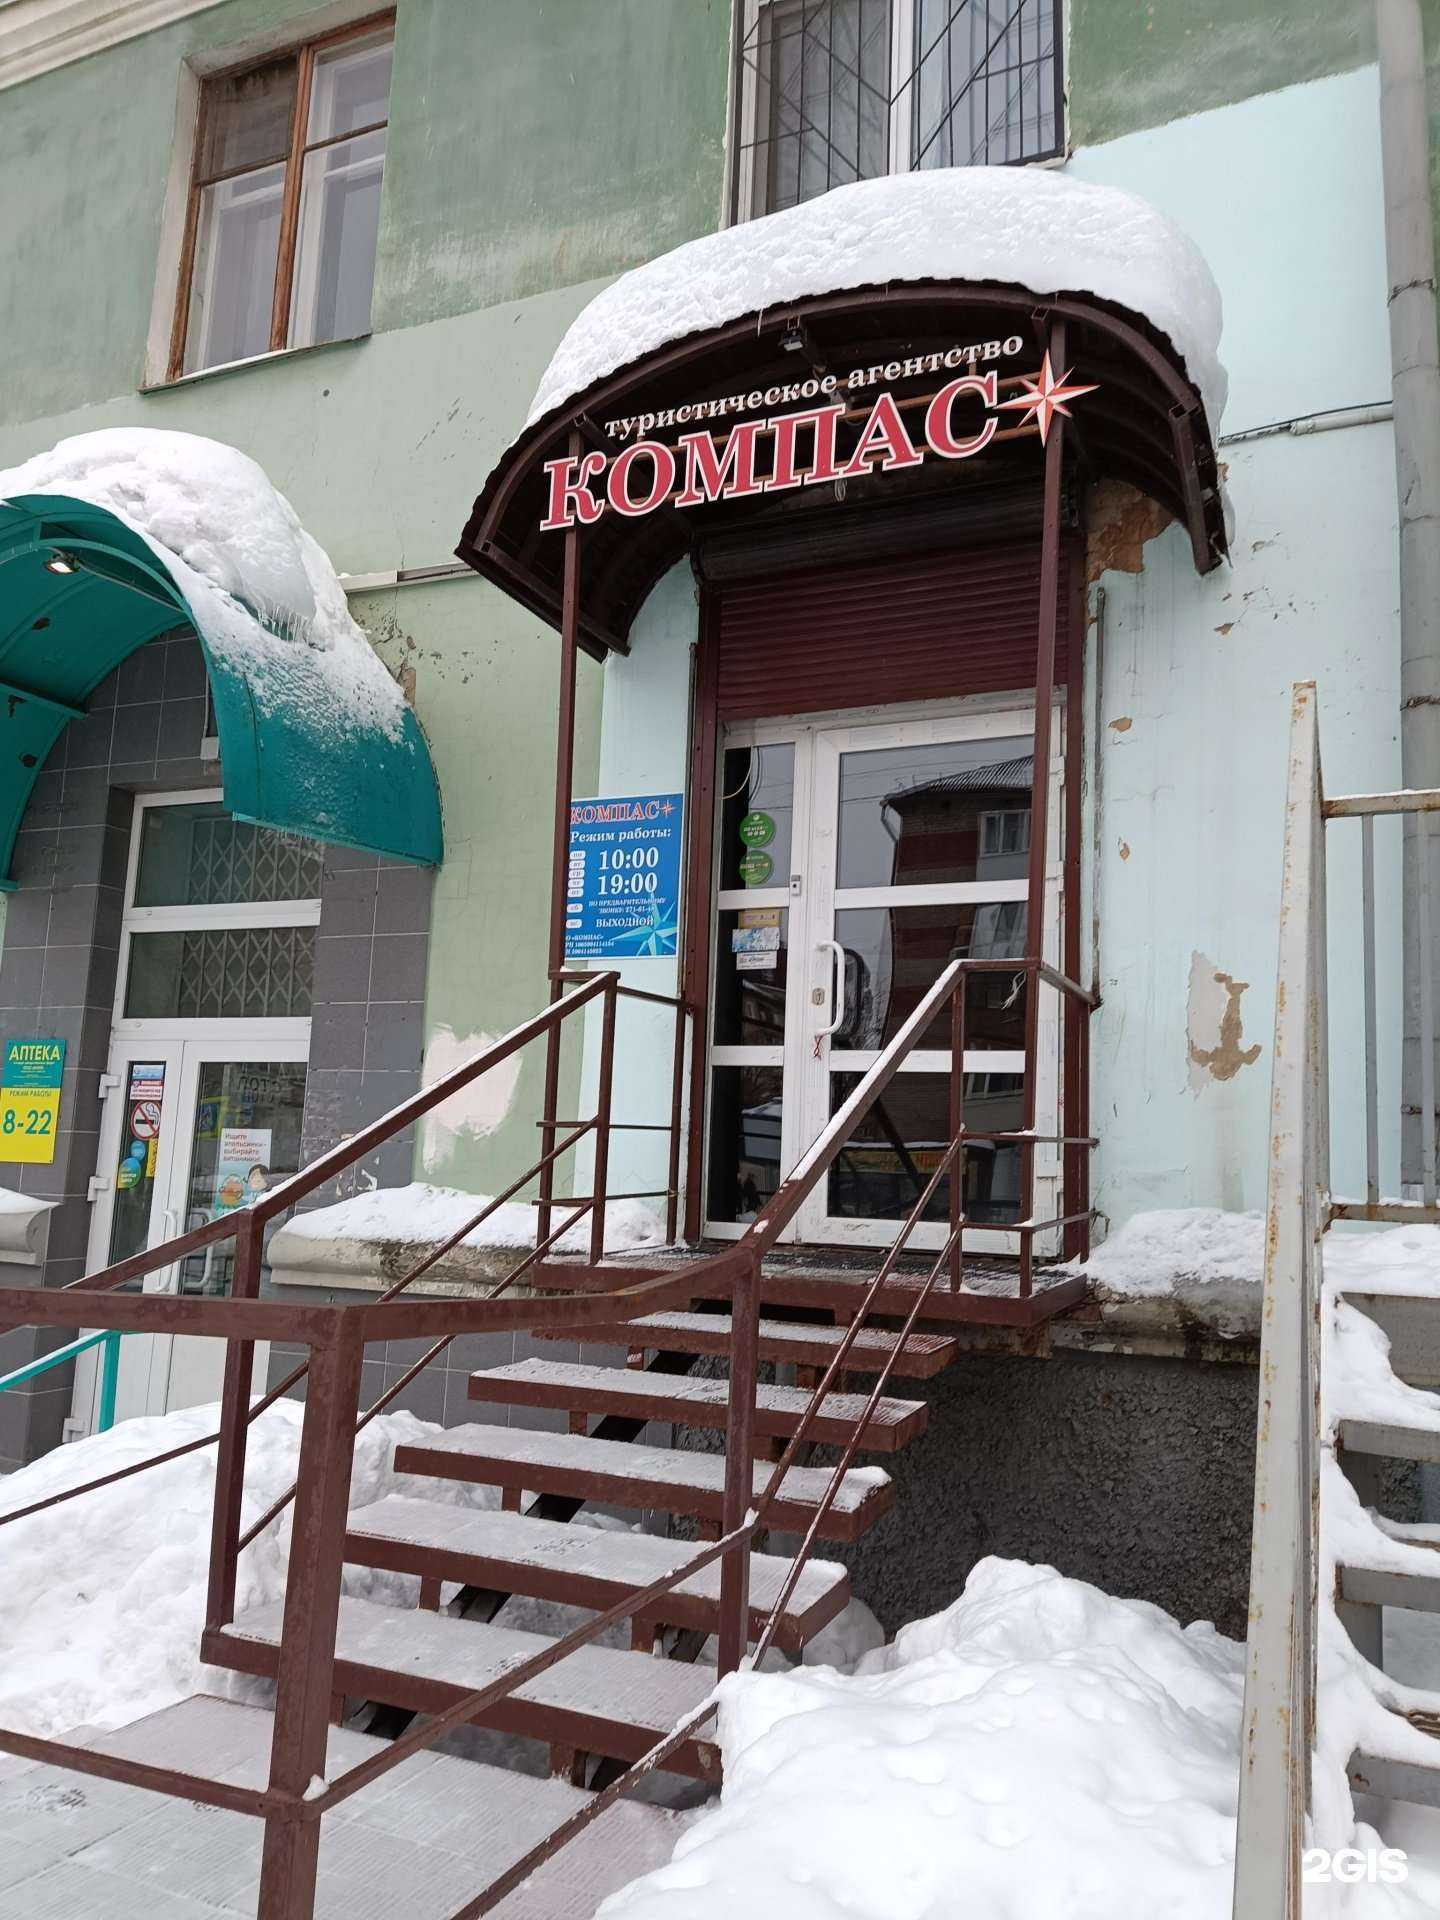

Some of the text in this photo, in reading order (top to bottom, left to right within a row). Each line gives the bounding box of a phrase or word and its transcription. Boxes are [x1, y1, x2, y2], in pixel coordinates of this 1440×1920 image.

[605, 335, 1024, 440] туристическое агентство
[539, 370, 999, 532] КОМПАС
[570, 800, 660, 824] КОМПАС
[570, 827, 672, 843] Режим работы:
[599, 847, 659, 870] 10:00
[598, 872, 658, 895] 19:00
[596, 915, 654, 927] ВЫХОДНОЙ
[9, 1045, 60, 1061] АПТЕКА
